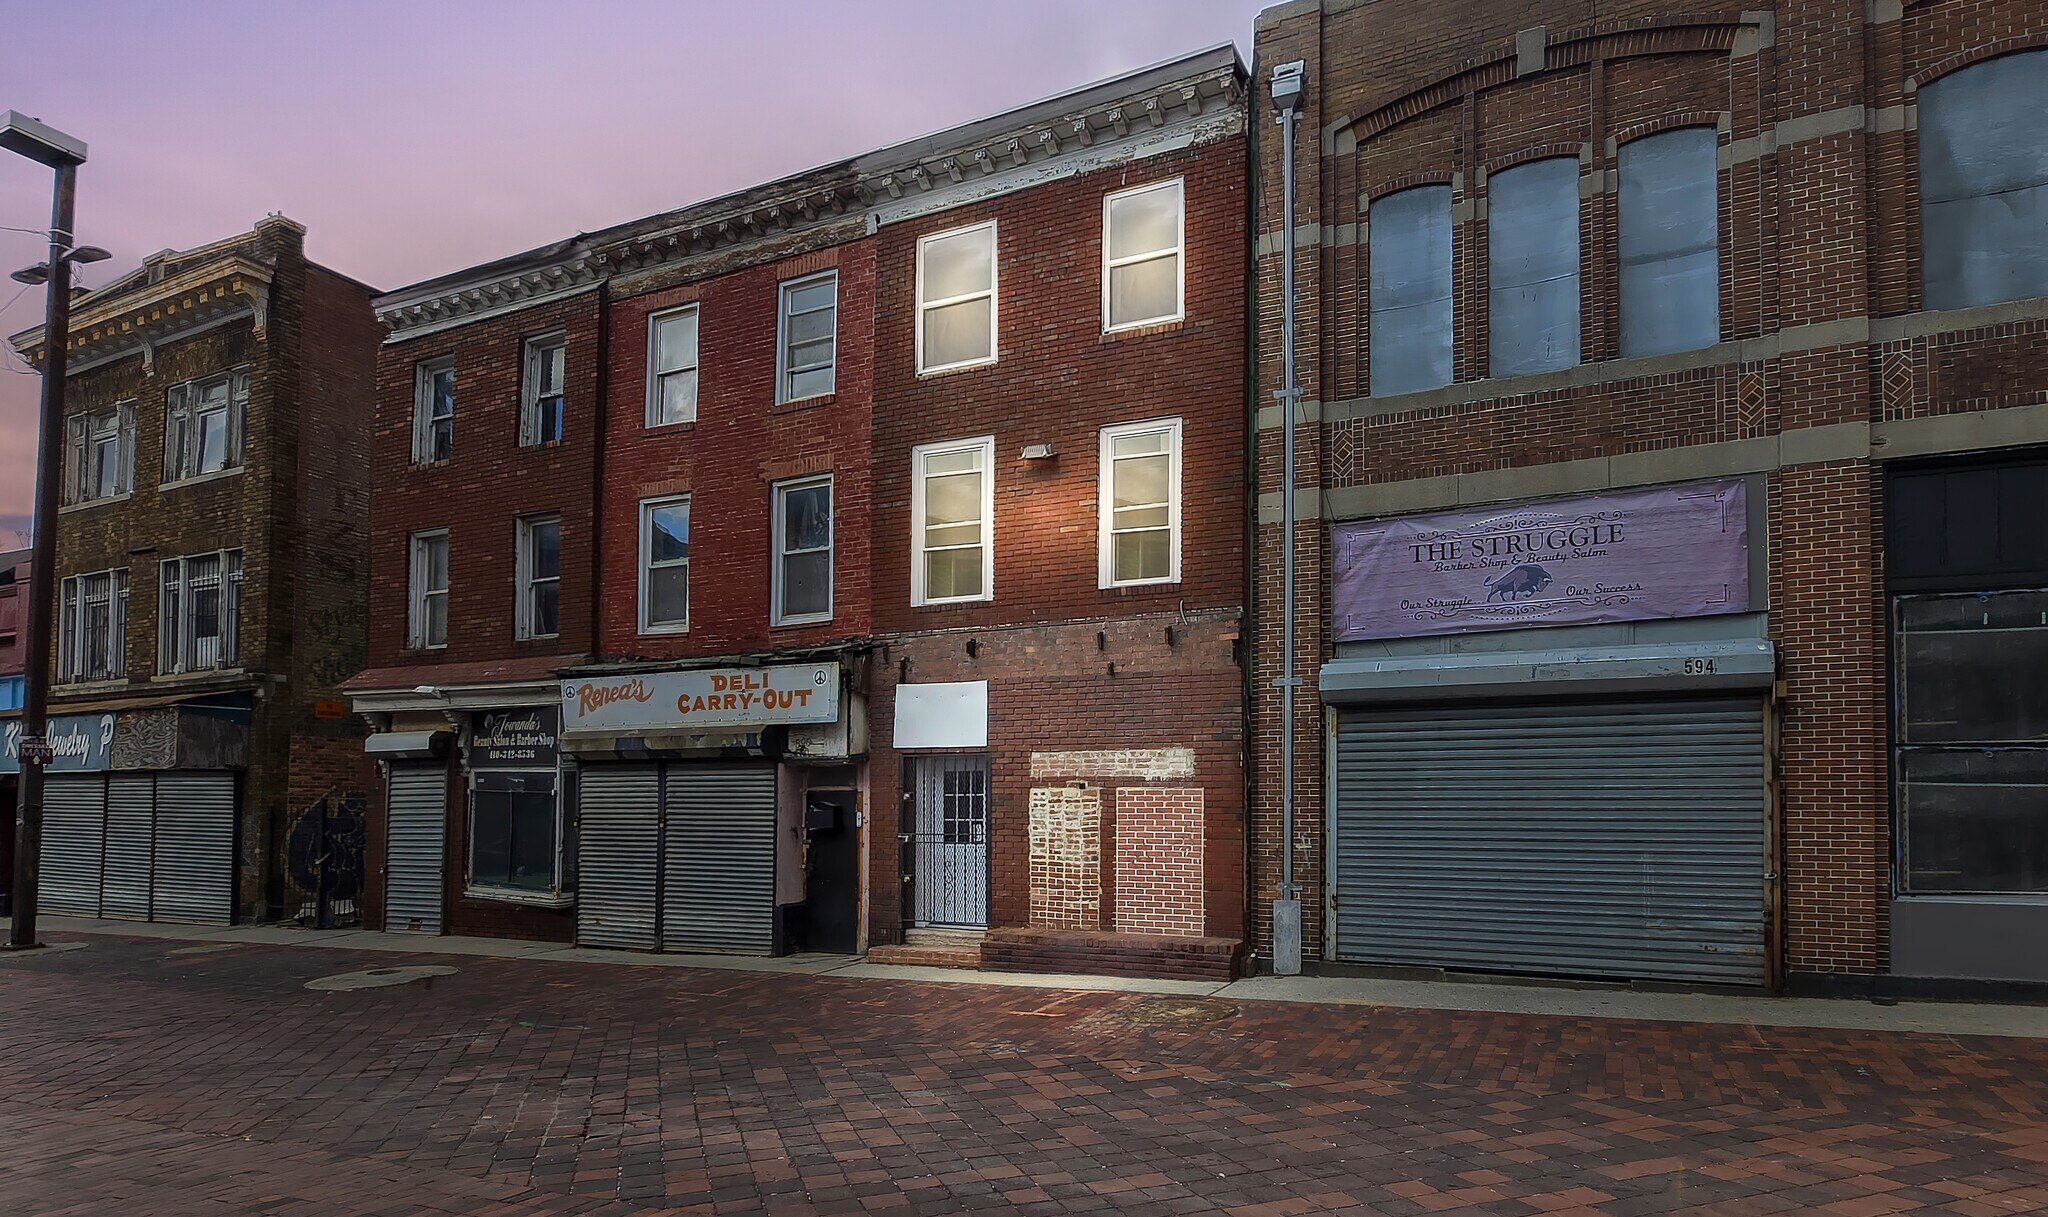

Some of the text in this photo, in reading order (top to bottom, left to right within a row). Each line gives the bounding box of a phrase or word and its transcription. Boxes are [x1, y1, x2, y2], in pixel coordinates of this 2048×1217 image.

[1409, 523, 1625, 563] THE STRUGGLE
[1432, 548, 1609, 573] Barber Shop & Beauty Salon
[1565, 582, 1644, 597] Our Success
[1400, 596, 1473, 612] Our Struggle
[1684, 659, 1714, 674] 594
[710, 672, 769, 692] DELI
[576, 678, 655, 718] Renea's
[677, 688, 813, 714] CARRY-OUT
[46, 720, 91, 766] Jewelry
[516, 733, 538, 746] Barber
[538, 732, 554, 748] Shop
[21, 748, 51, 757] MAN
